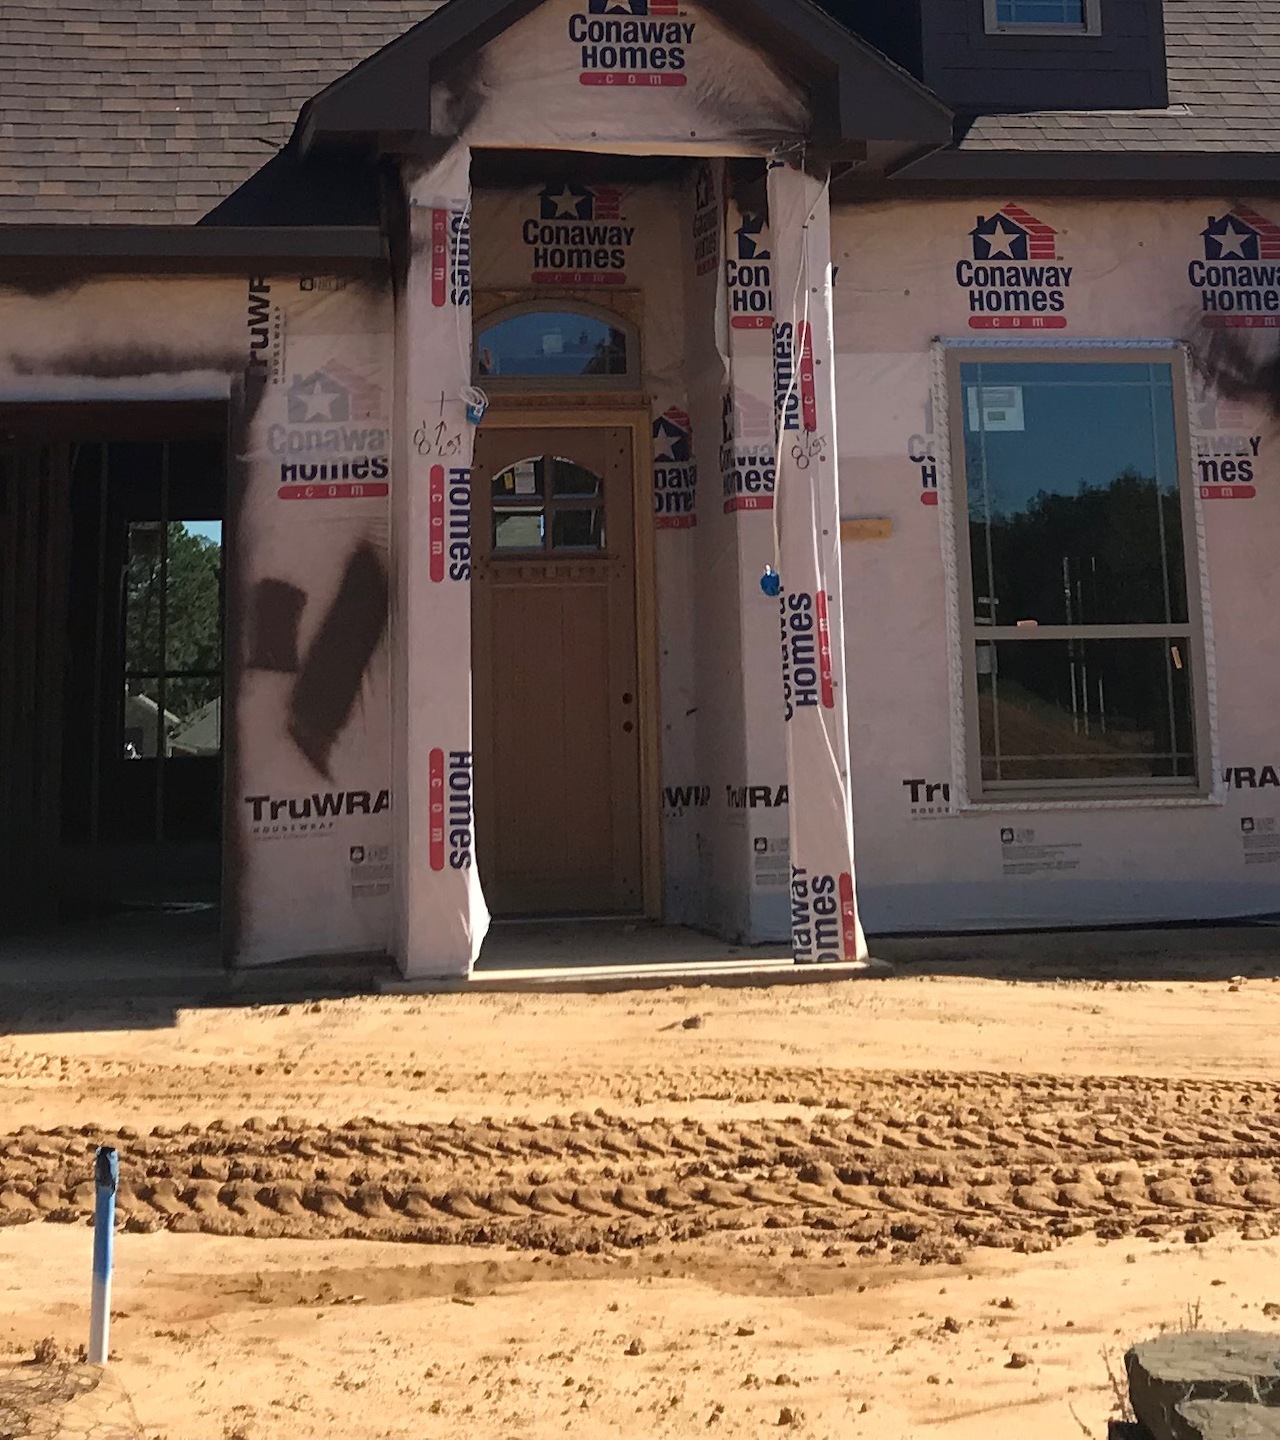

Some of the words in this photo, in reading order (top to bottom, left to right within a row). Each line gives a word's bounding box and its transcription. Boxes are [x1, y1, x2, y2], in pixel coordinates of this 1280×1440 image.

[568, 14, 696, 44] Conaway
[581, 45, 686, 70] Homes
[522, 221, 635, 246] Conaway
[533, 246, 626, 269] Homes
[956, 260, 1073, 287] Conaway
[969, 288, 1064, 312] Homes
[449, 468, 472, 581] Homes
[788, 592, 818, 707] Homes
[449, 751, 473, 870] Homes
